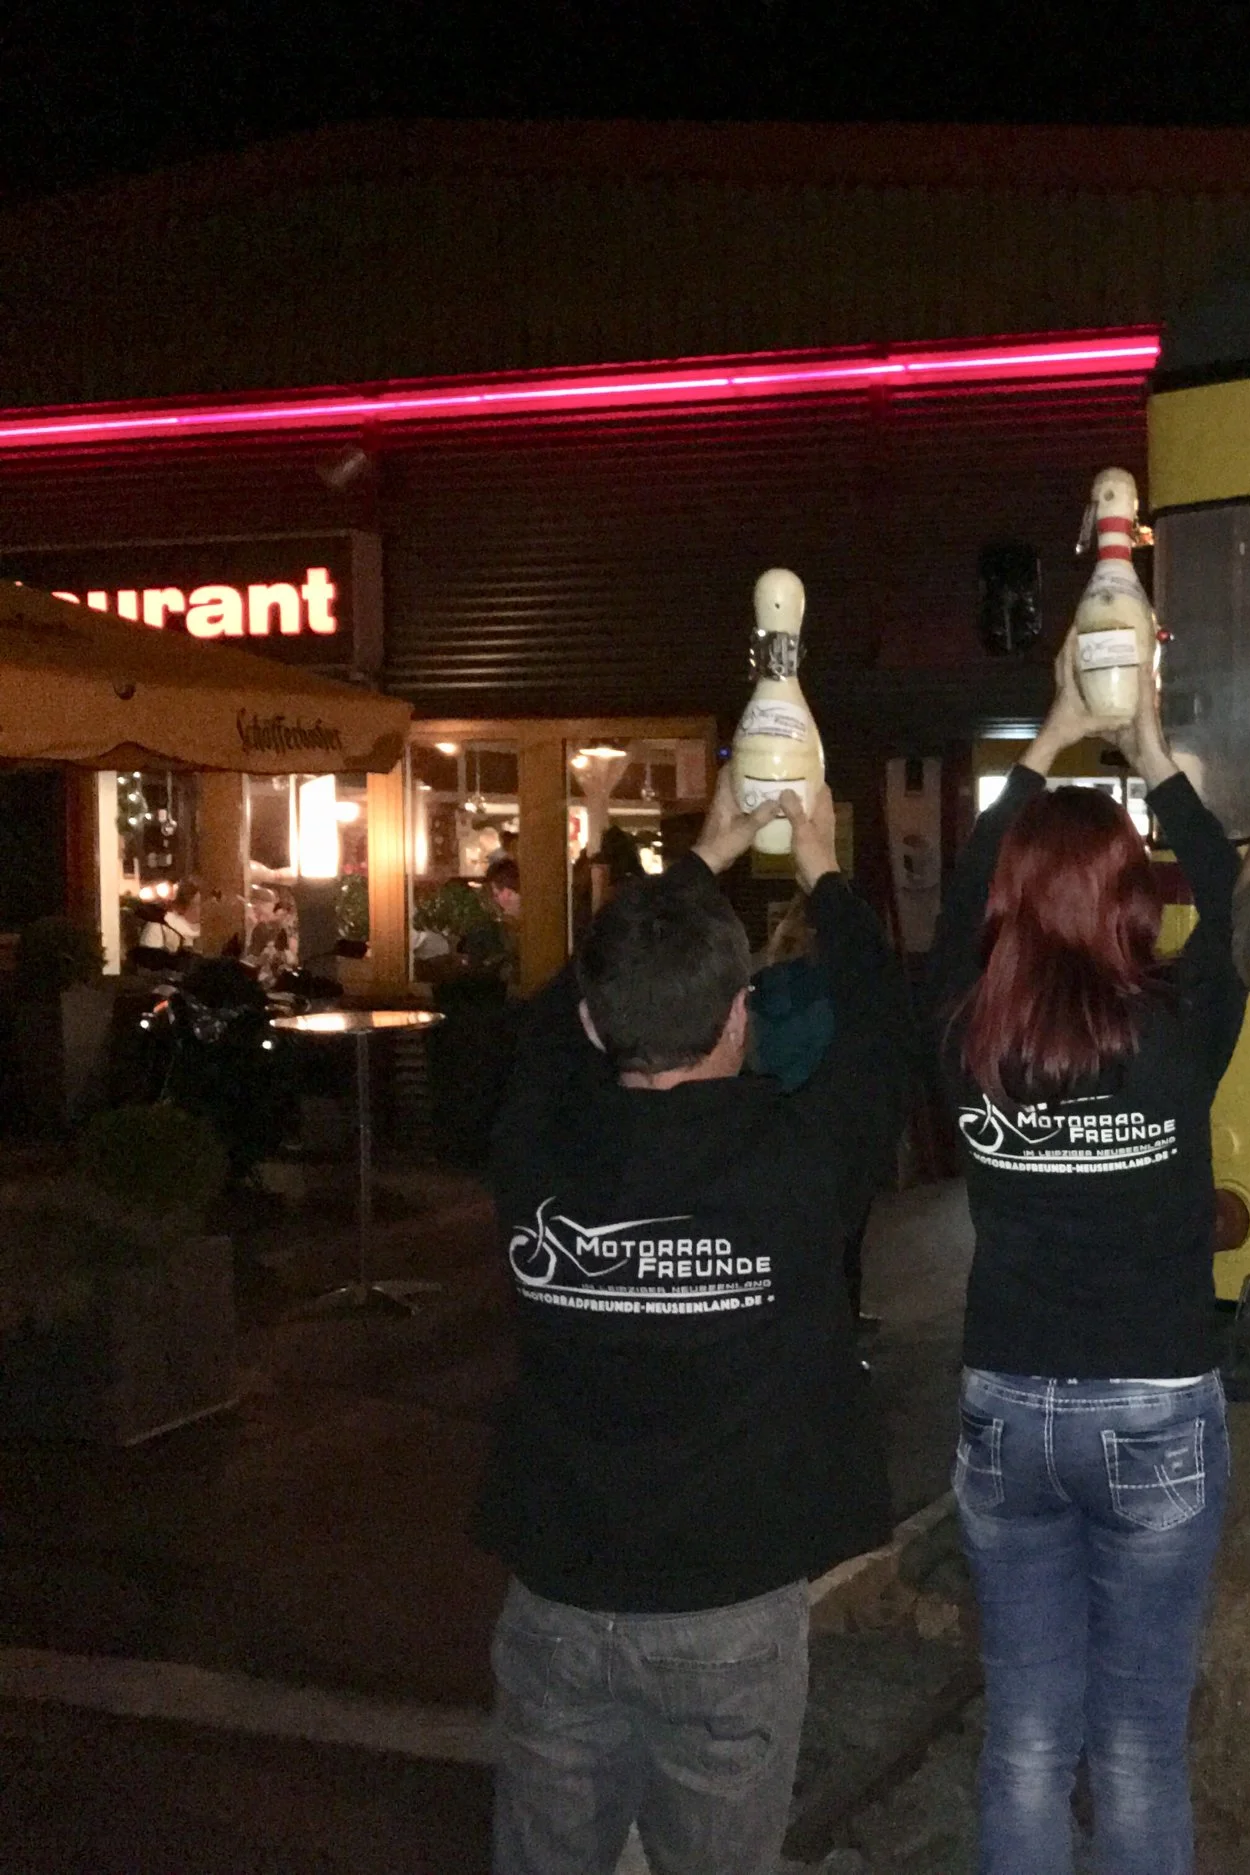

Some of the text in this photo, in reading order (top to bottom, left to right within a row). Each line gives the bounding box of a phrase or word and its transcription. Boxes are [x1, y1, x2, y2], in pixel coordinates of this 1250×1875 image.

[1017, 1111, 1145, 1129] MOTORRAD
[1069, 1119, 1176, 1143] FREUNDE
[575, 1236, 732, 1258] MOTORRAD
[637, 1256, 772, 1279] FREUNDE
